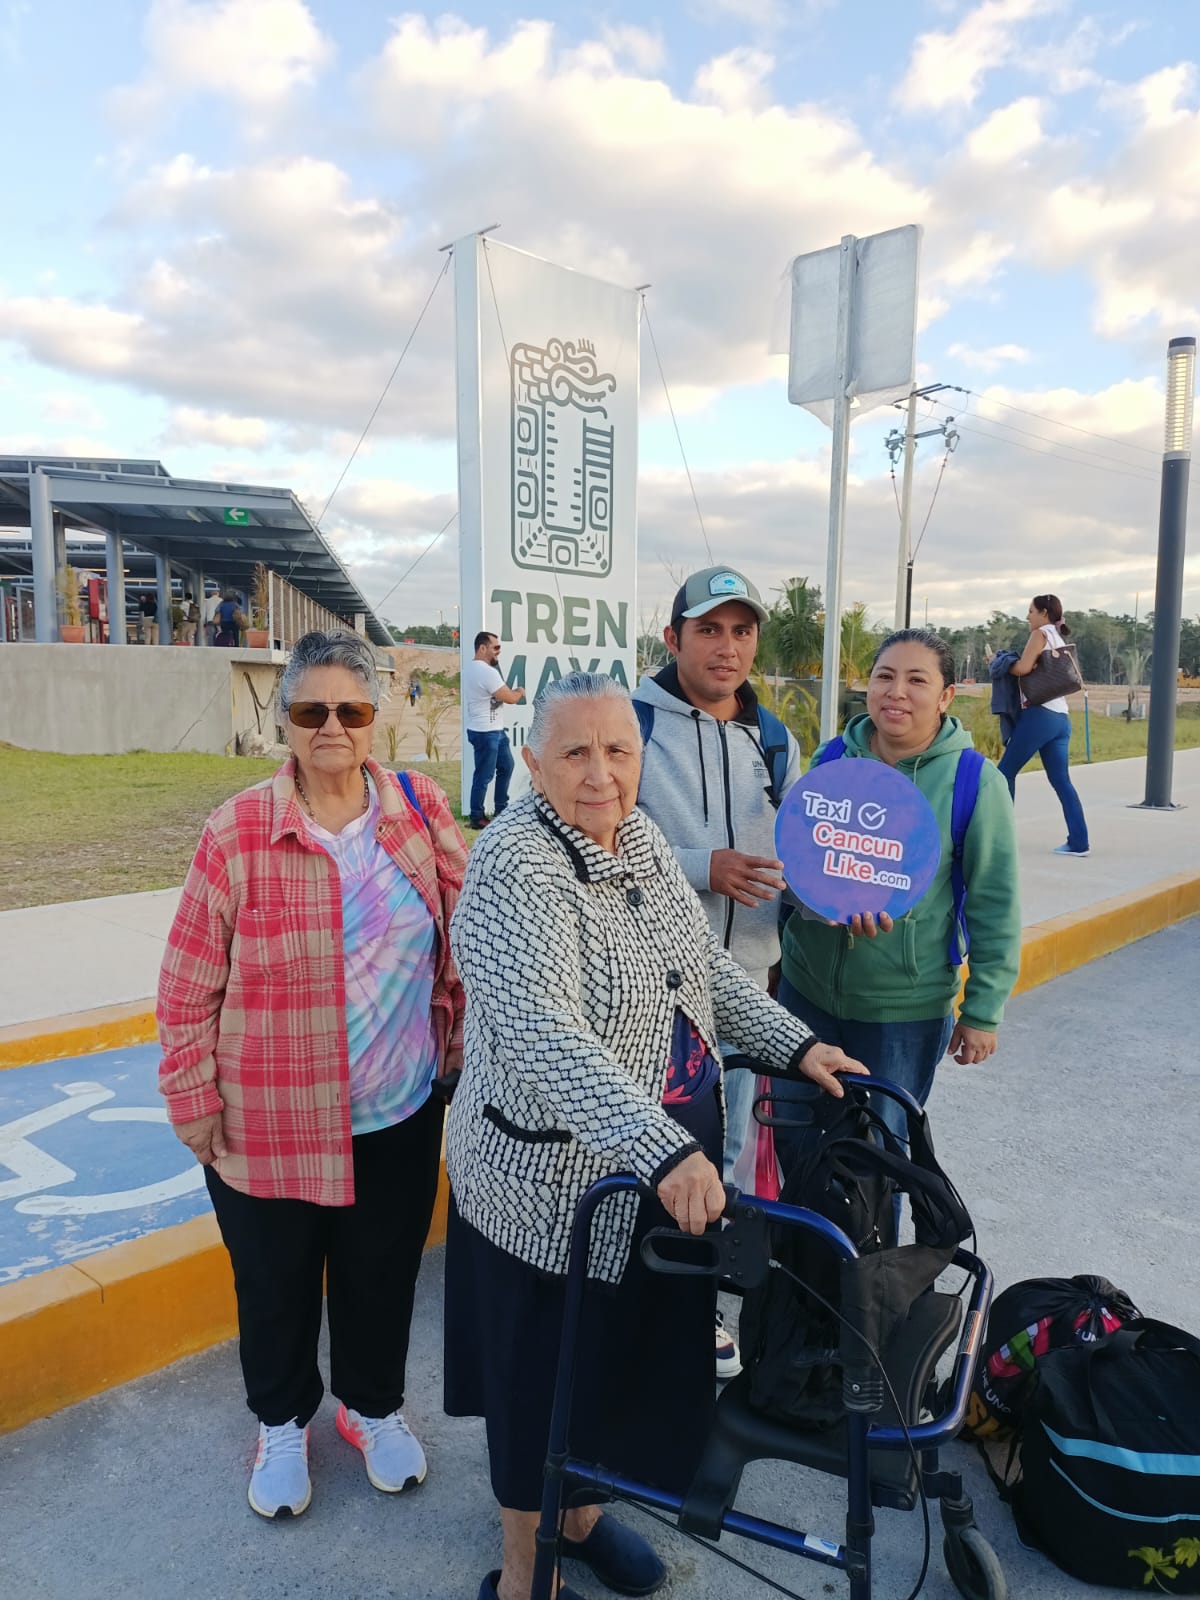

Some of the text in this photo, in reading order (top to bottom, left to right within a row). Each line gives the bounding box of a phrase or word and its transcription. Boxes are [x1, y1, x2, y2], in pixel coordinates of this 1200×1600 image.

[491, 589, 628, 648] TREN
[803, 792, 851, 822] Taxi
[814, 823, 902, 860] Cancun
[825, 853, 910, 889] Like.com
